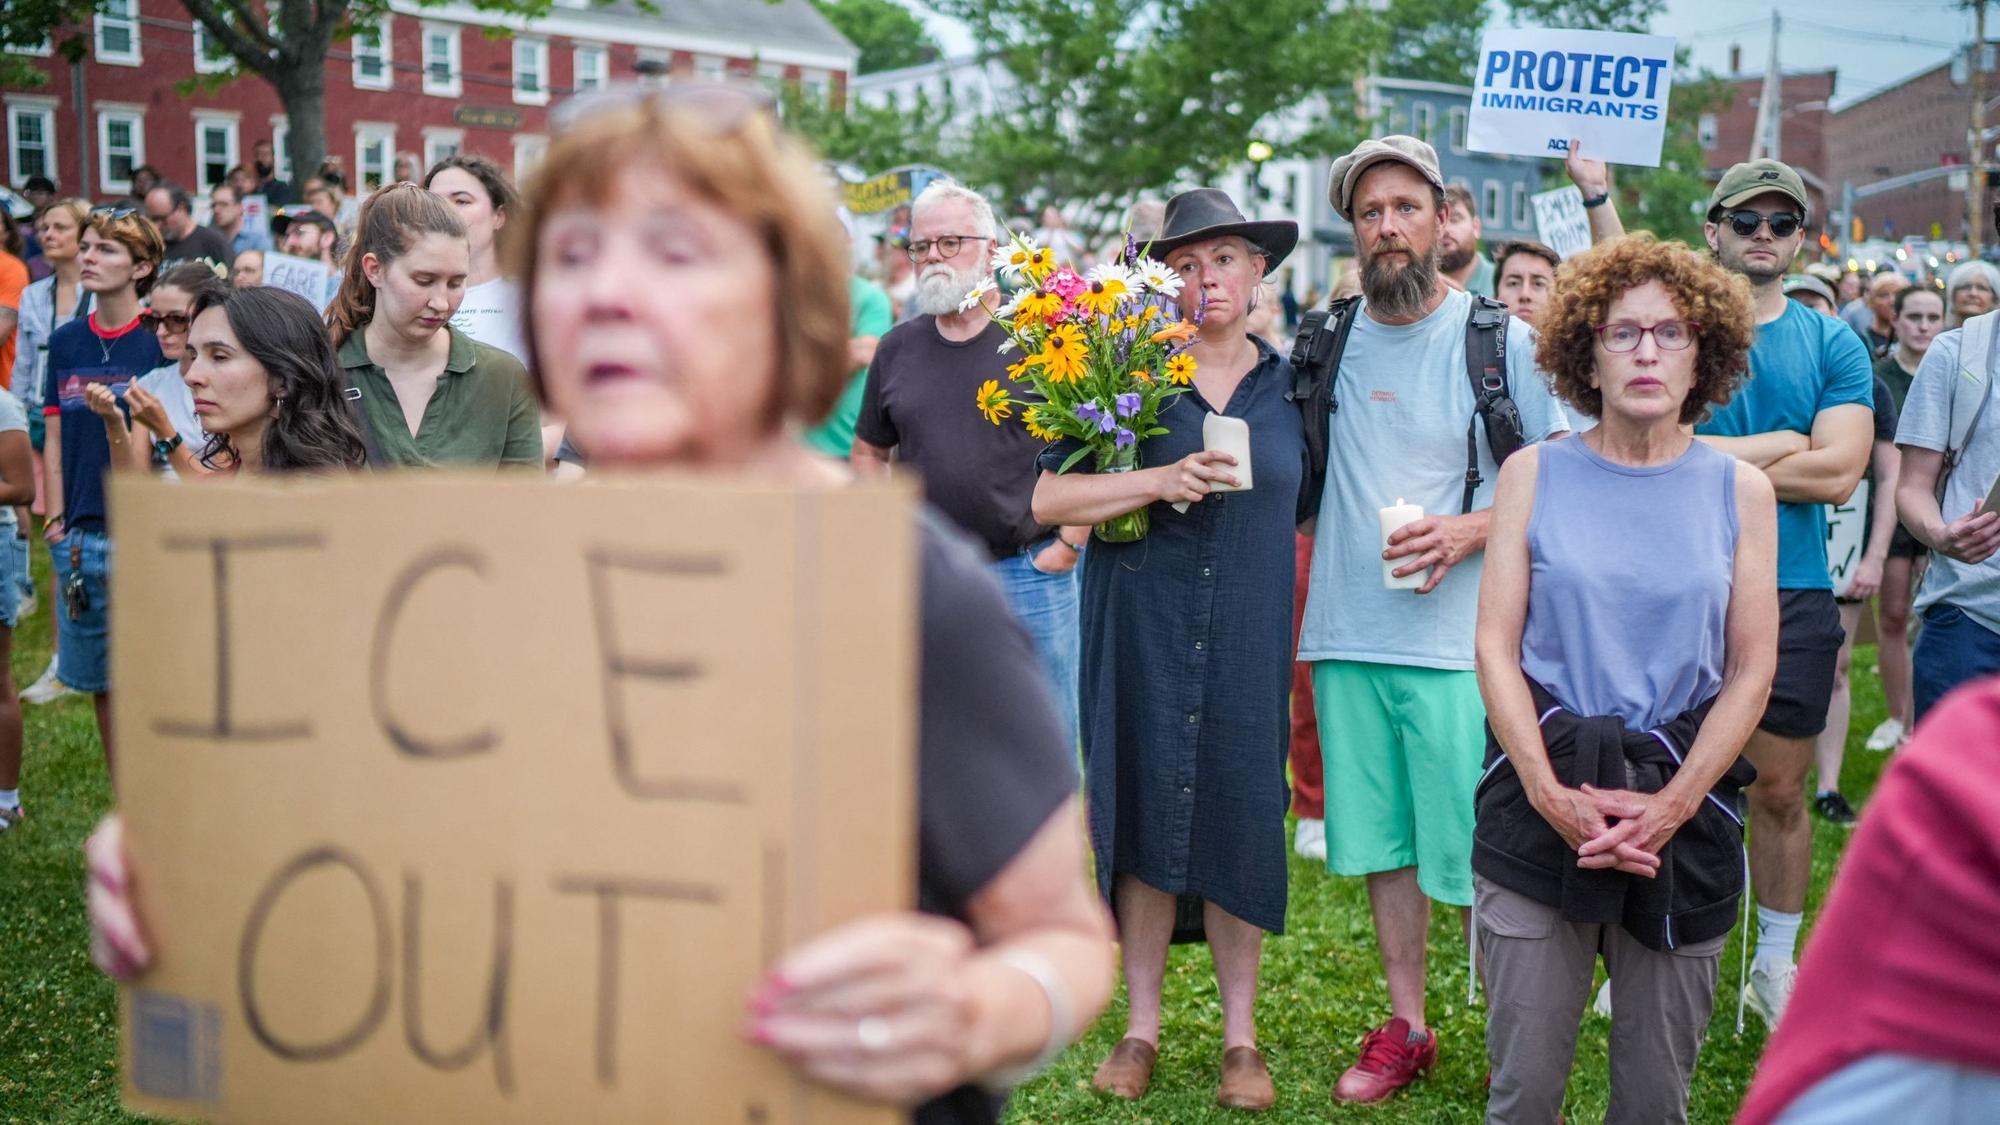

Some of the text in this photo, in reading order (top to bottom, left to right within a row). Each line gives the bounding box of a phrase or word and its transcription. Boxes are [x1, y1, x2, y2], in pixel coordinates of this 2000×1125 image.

[1483, 50, 1667, 99] PROTECT
[1481, 92, 1659, 121] IMMIGRANTS
[1547, 138, 1580, 151] ACL
[151, 533, 748, 803] ICE
